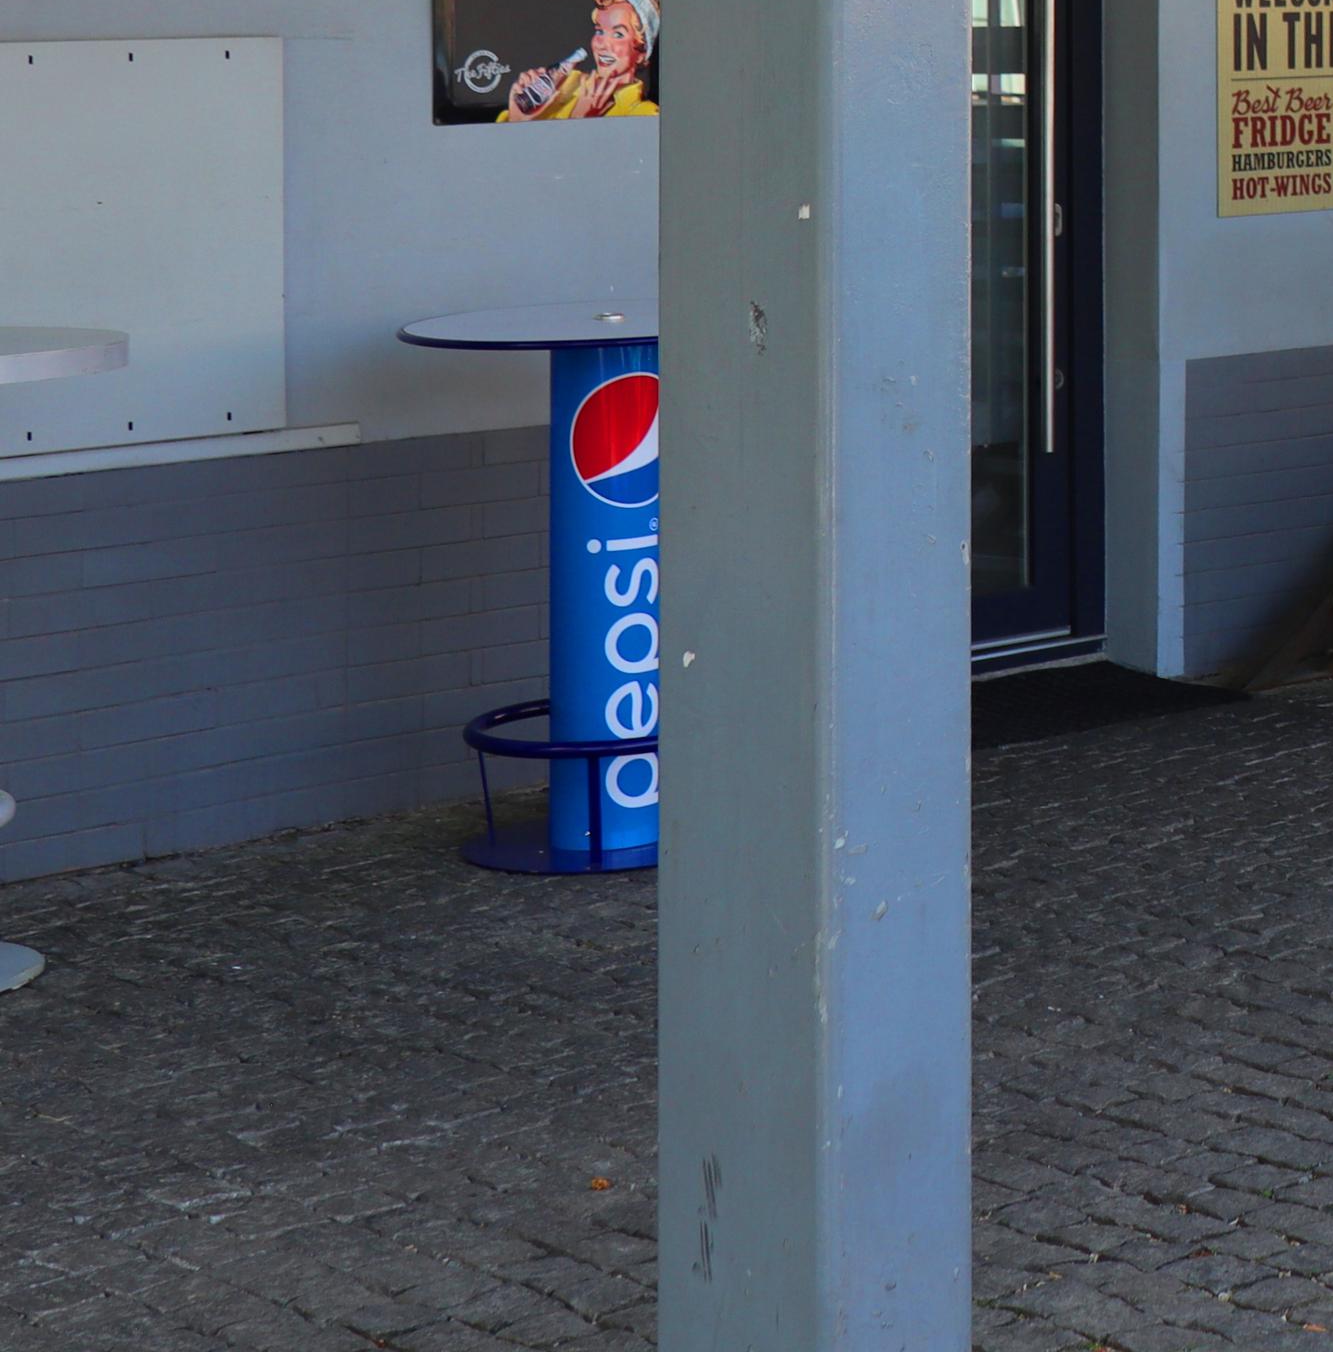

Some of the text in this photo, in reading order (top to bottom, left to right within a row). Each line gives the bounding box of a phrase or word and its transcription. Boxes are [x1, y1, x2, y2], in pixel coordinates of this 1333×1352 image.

[1233, 12, 1268, 72] IN
[1232, 85, 1333, 115] Best Beer
[1231, 113, 1331, 150] FRIDGE
[1231, 149, 1332, 173] HAMBURGERS
[1231, 173, 1332, 201] HOT-WINGS
